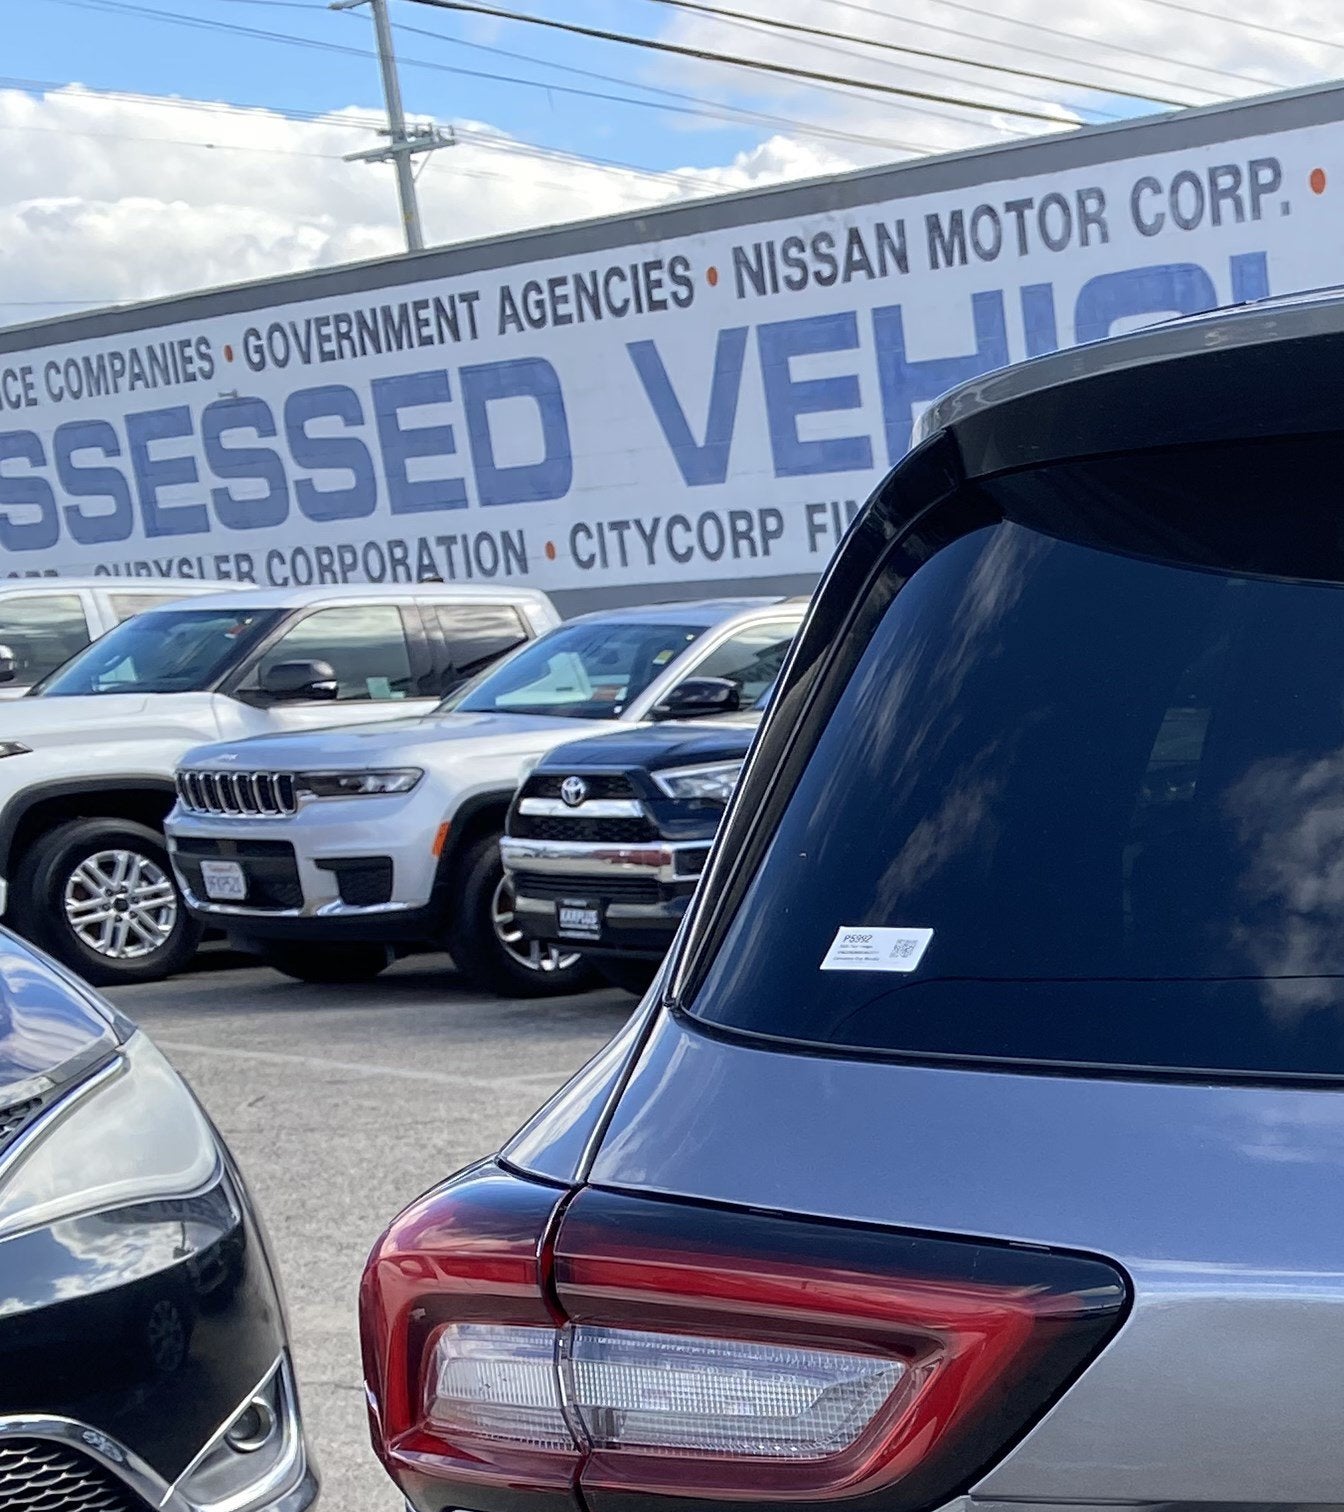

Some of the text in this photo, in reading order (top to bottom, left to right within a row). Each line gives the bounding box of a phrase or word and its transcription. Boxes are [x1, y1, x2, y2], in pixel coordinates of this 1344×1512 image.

[44, 336, 216, 403] COMPANIES
[243, 291, 480, 372] GOVERNMENT
[498, 255, 695, 336] AGENCIES
[733, 218, 909, 299] NISSAN
[926, 186, 1109, 270] MOTOR
[1130, 156, 1291, 238] CORP.
[265, 529, 530, 588] CORPORATION
[569, 507, 785, 570] CITYCORP
